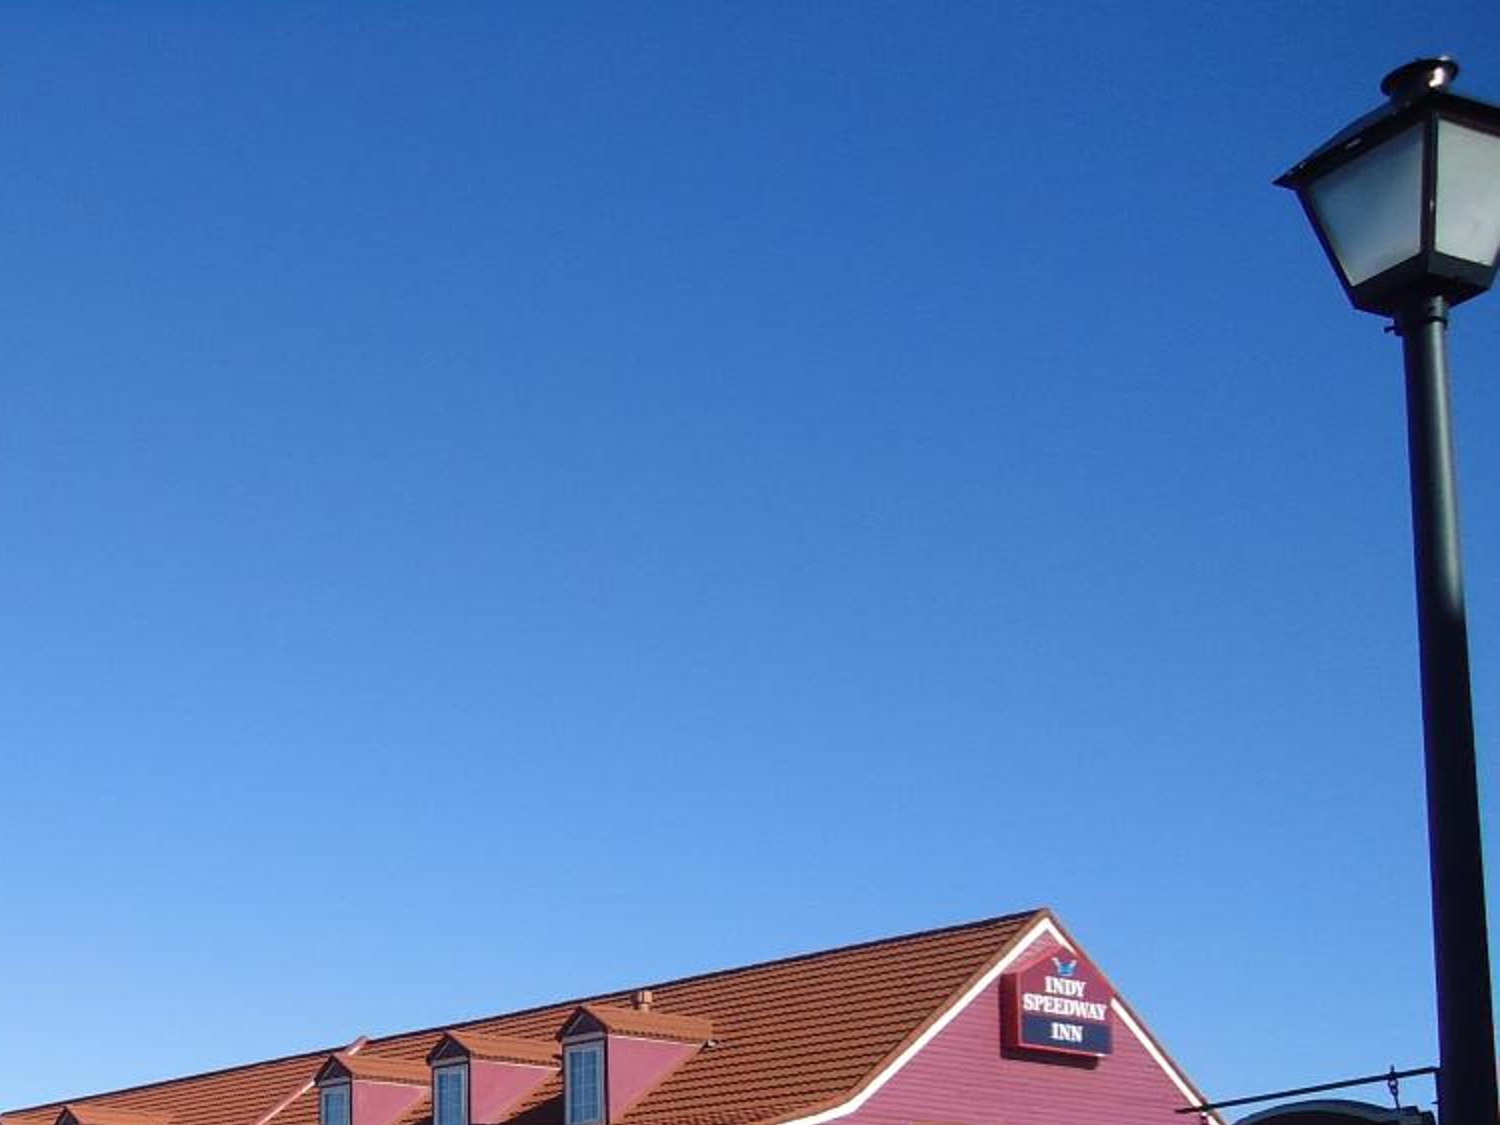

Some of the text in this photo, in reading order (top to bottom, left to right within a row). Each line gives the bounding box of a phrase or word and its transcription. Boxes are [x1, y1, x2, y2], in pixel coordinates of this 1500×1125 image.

[1044, 976, 1086, 997] INDY
[1023, 993, 1107, 1020] SPEEDWAY
[1052, 1022, 1083, 1042] INN
